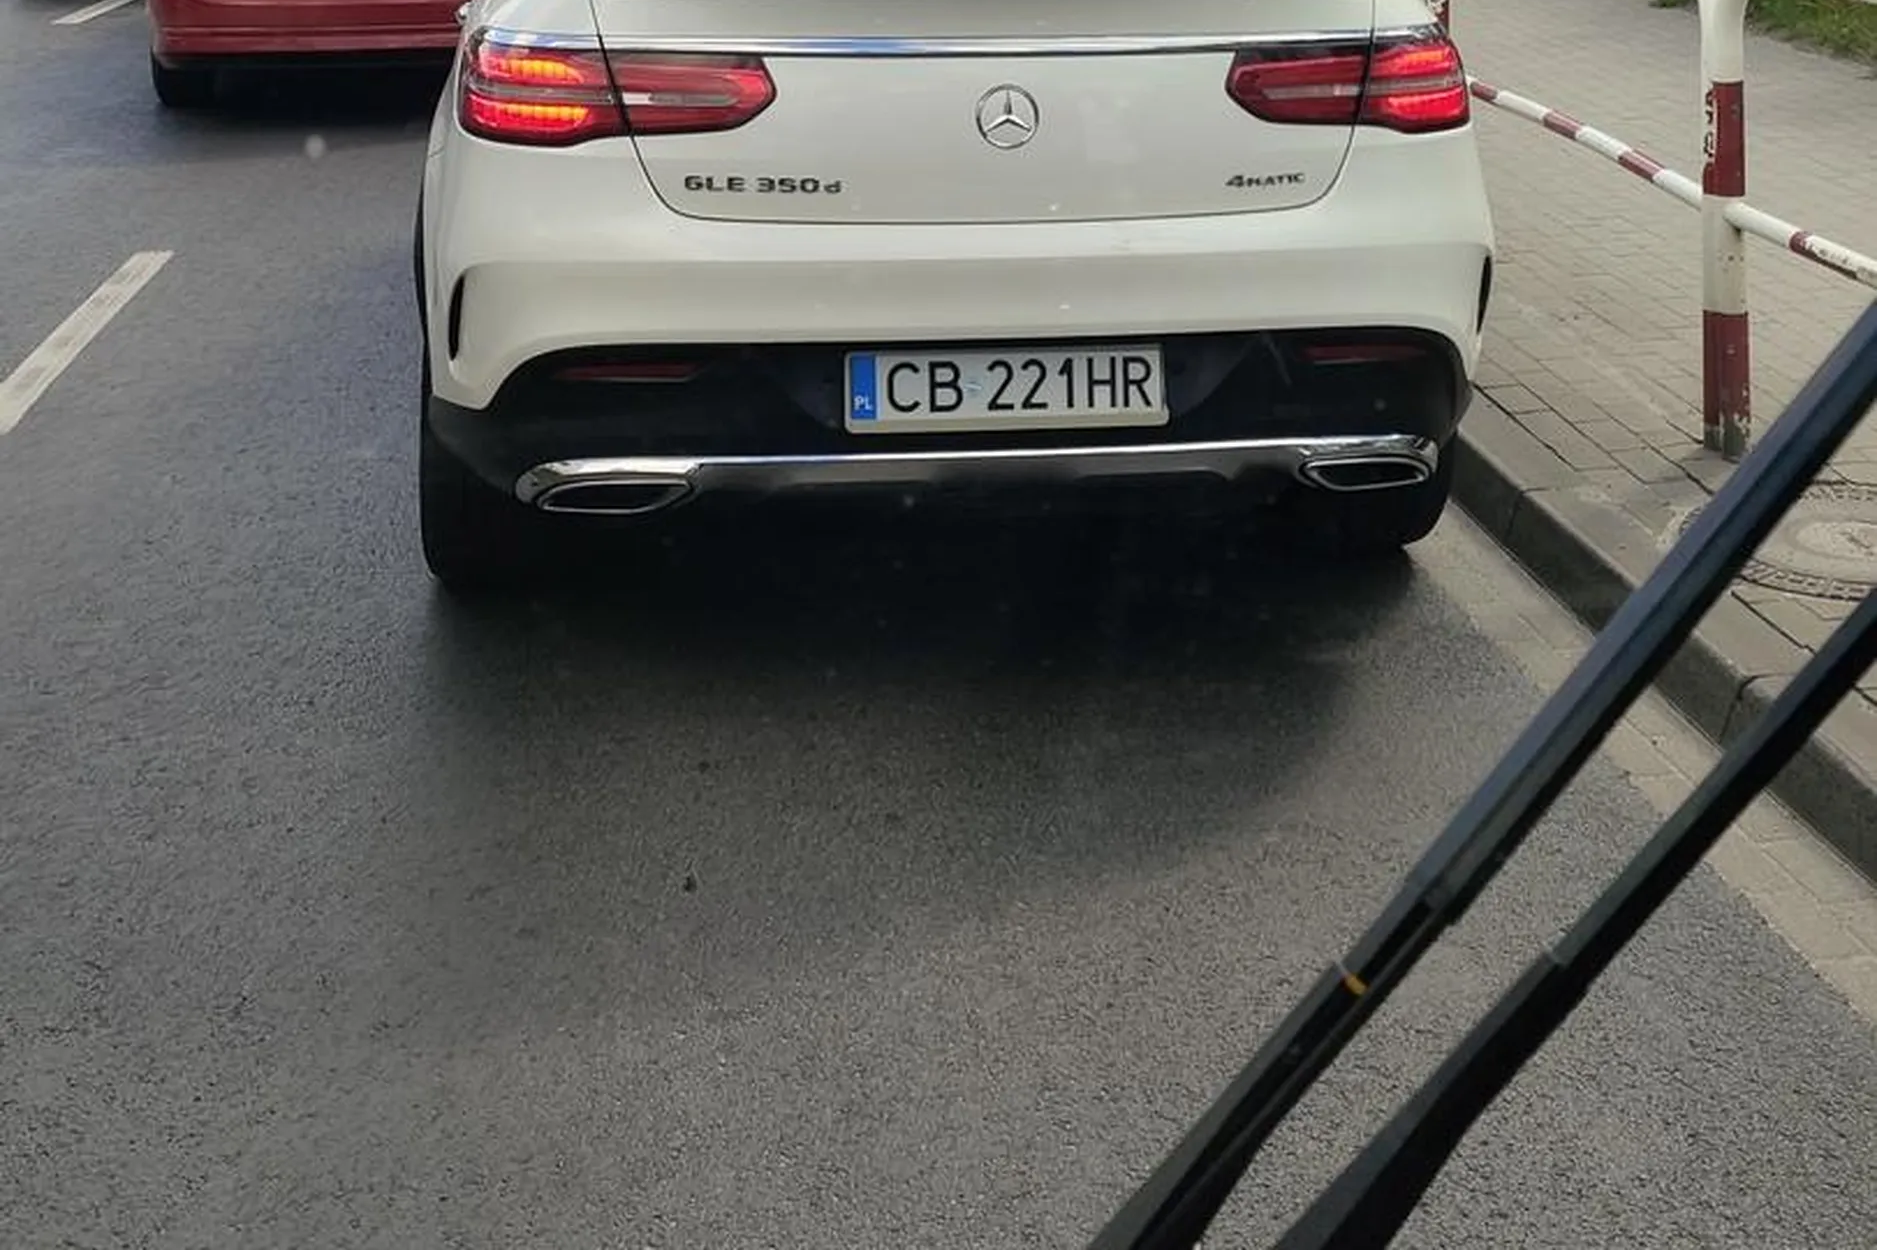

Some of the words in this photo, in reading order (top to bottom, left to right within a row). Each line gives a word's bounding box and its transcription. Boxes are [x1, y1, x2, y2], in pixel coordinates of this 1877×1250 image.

[684, 175, 746, 192] GLE
[756, 177, 842, 193] 350d
[1225, 172, 1305, 188] 4MATIC
[886, 360, 964, 413] CB
[987, 355, 1153, 412] 221HR
[853, 396, 873, 411] PL
